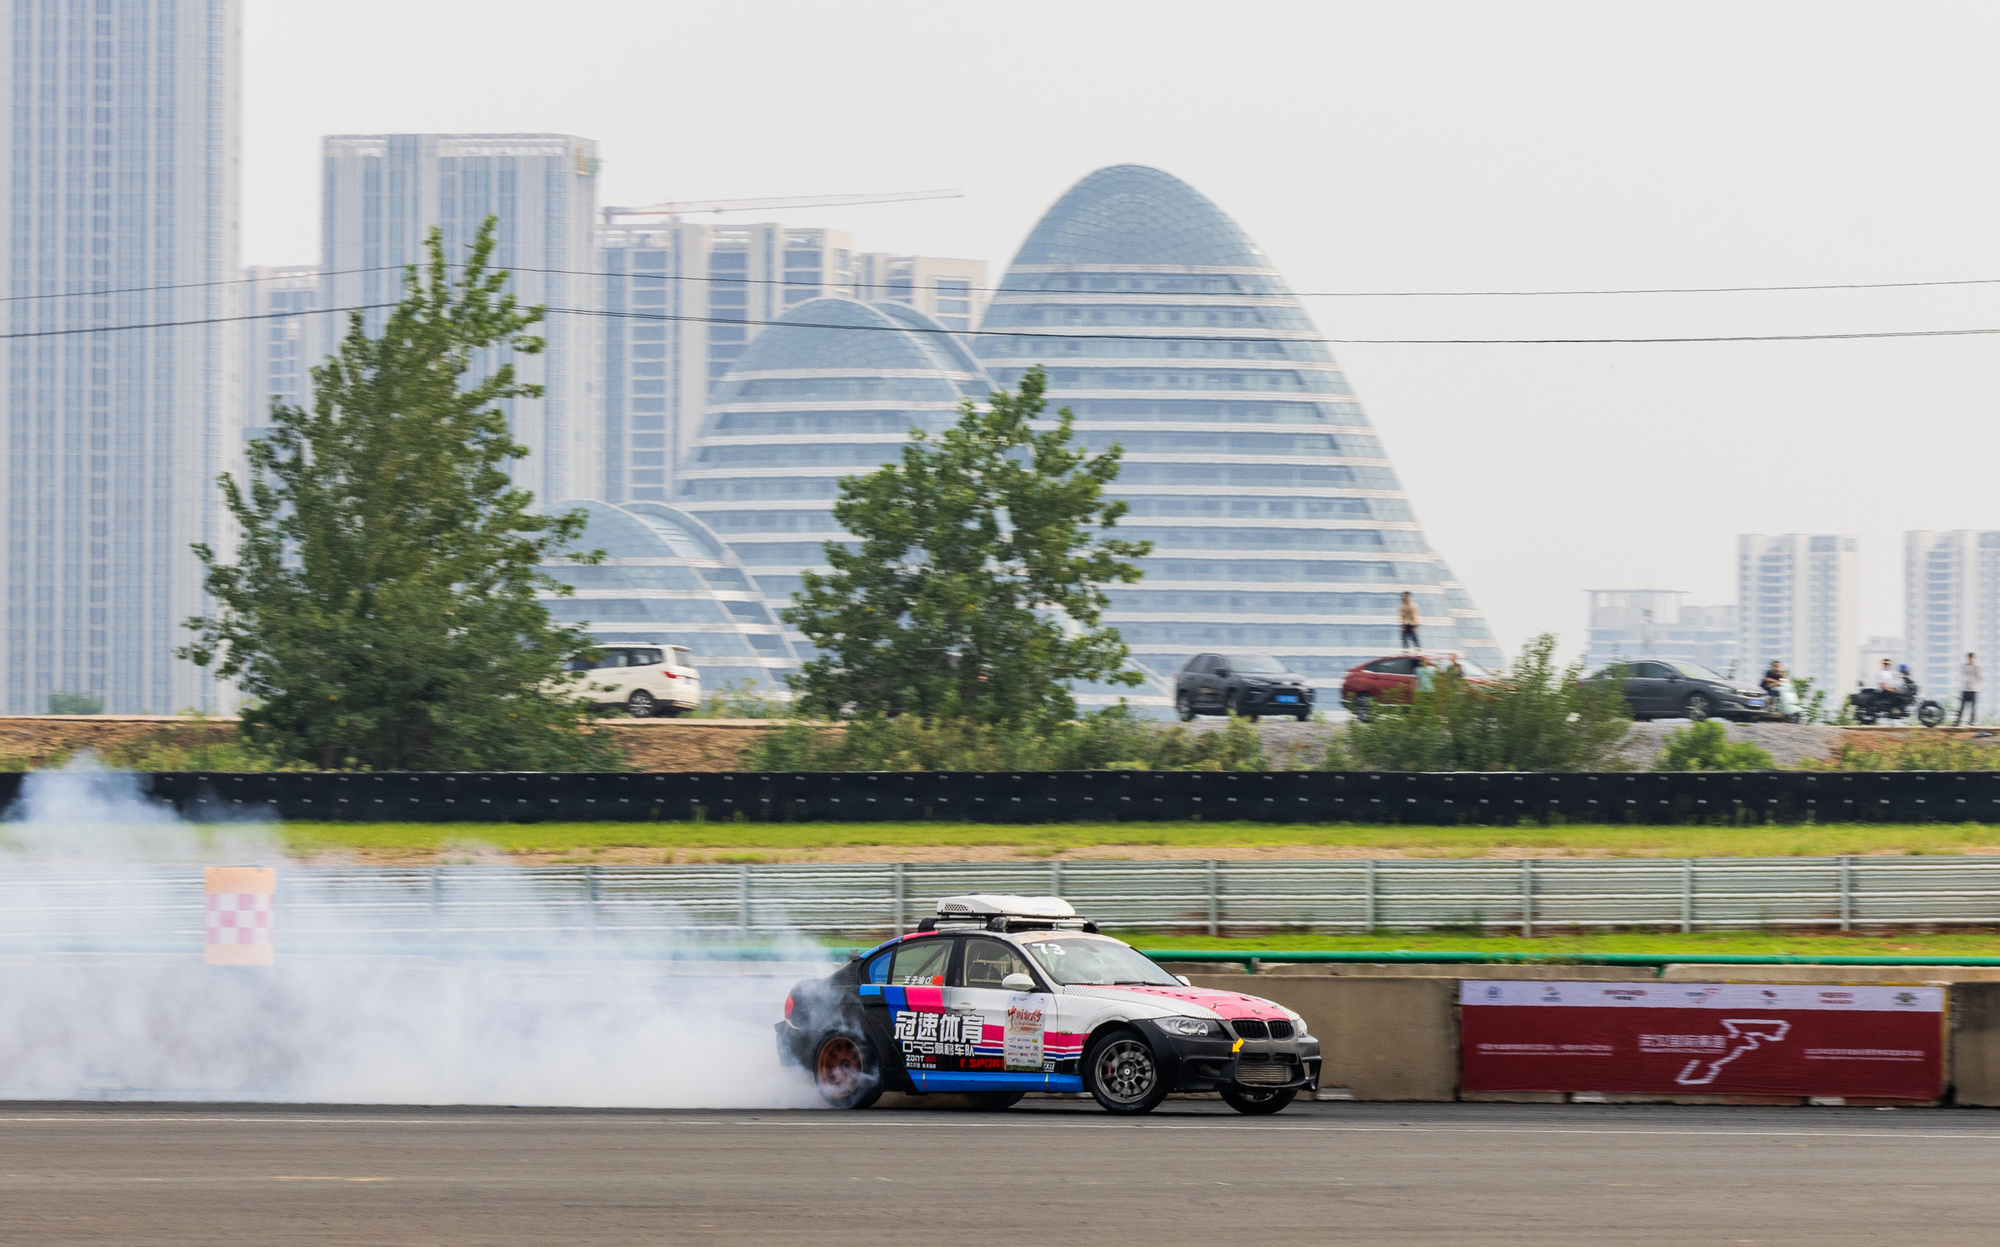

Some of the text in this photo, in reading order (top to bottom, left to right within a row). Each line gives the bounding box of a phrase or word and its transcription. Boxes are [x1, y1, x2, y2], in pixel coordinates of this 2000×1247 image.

[1031, 942, 1066, 956] 73
[894, 1010, 984, 1044] 冠速体育
